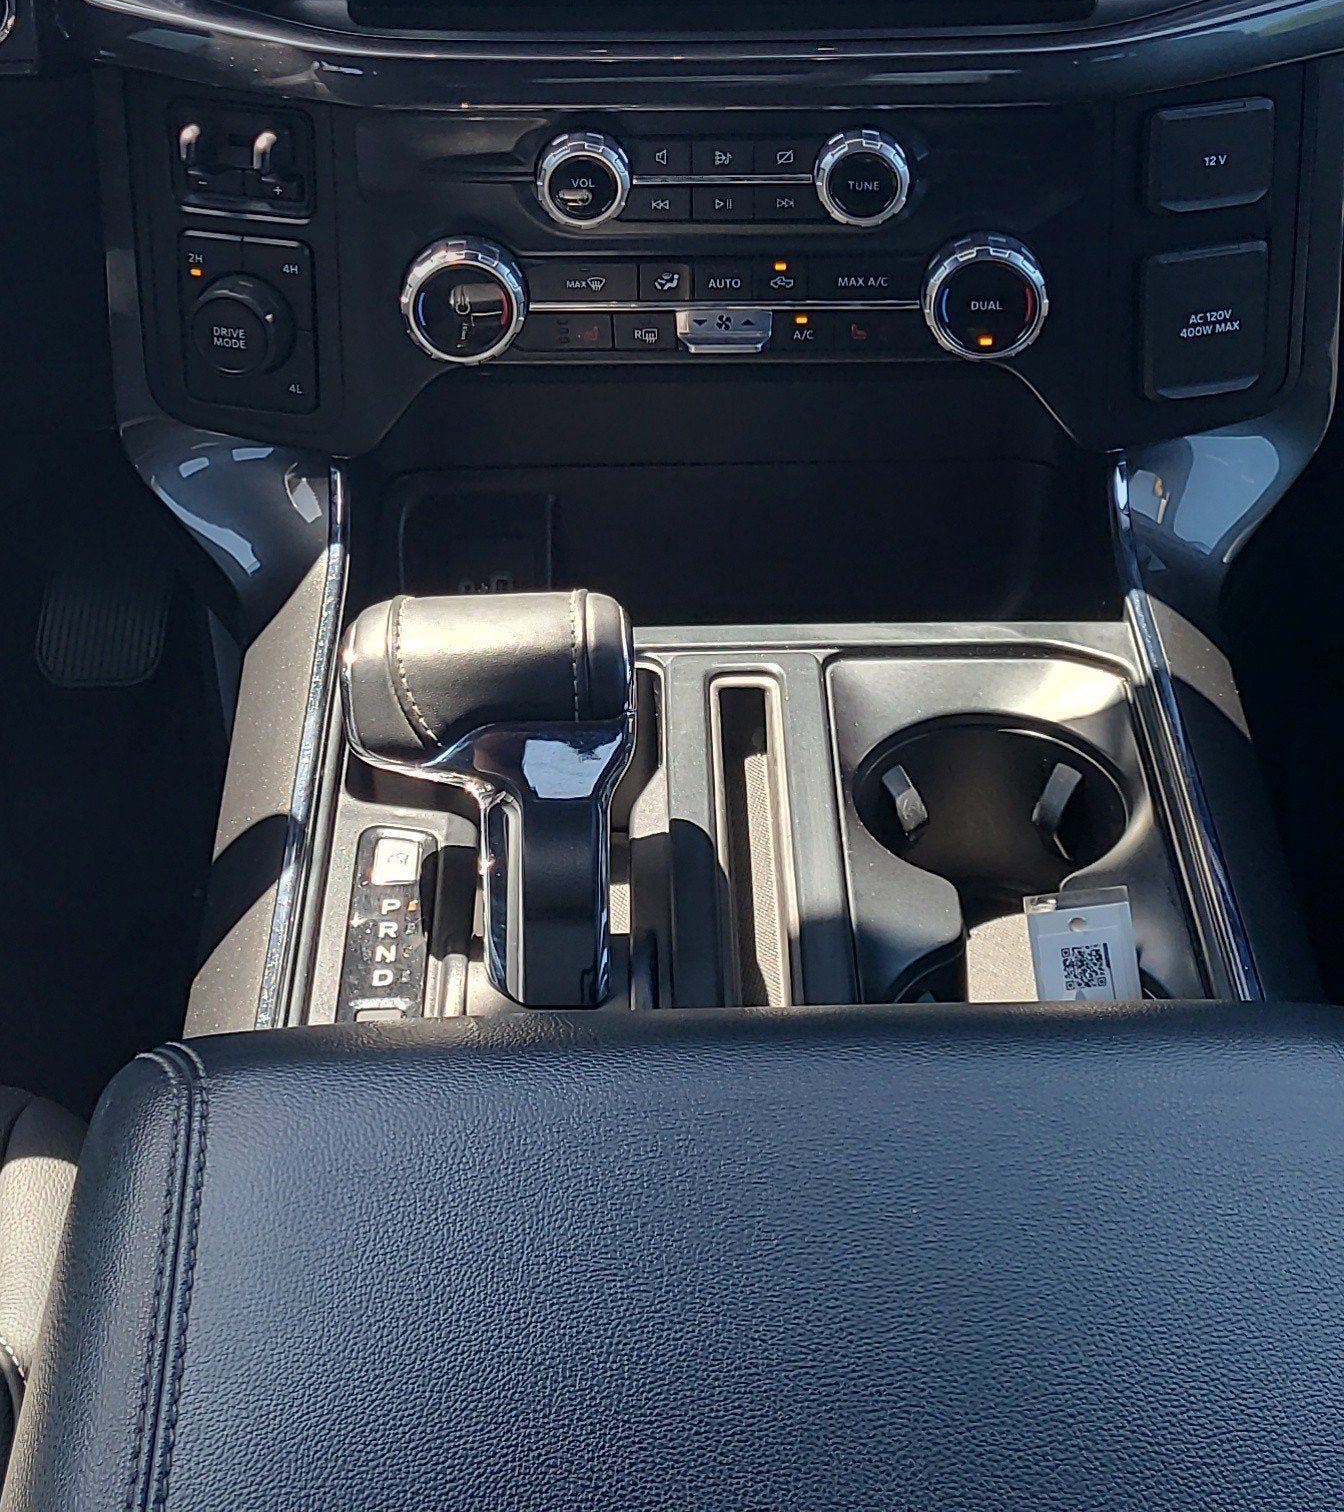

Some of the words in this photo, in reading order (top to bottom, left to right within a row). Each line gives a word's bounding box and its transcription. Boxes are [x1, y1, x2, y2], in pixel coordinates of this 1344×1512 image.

[1204, 156, 1217, 167] 12
[1218, 155, 1227, 164] V
[571, 178, 595, 188] VOL
[848, 181, 880, 191] TUNE
[188, 253, 203, 263] 2H
[283, 264, 299, 275] 4H
[566, 280, 586, 289] MAX
[709, 279, 741, 289] AUTO
[838, 276, 865, 287] MAX
[868, 276, 889, 287] A/C
[971, 300, 1003, 311] DUAL
[1189, 313, 1204, 324] AC
[1206, 309, 1232, 322] 120V
[213, 327, 245, 338] DRIVE
[1180, 325, 1213, 338] 400W
[1215, 320, 1240, 332] MAX
[793, 330, 814, 340] A/C
[213, 337, 246, 349] MODE
[289, 384, 303, 394] 4L
[381, 899, 401, 915] P
[378, 922, 399, 938] R
[374, 945, 396, 962] N
[371, 969, 394, 987] D
